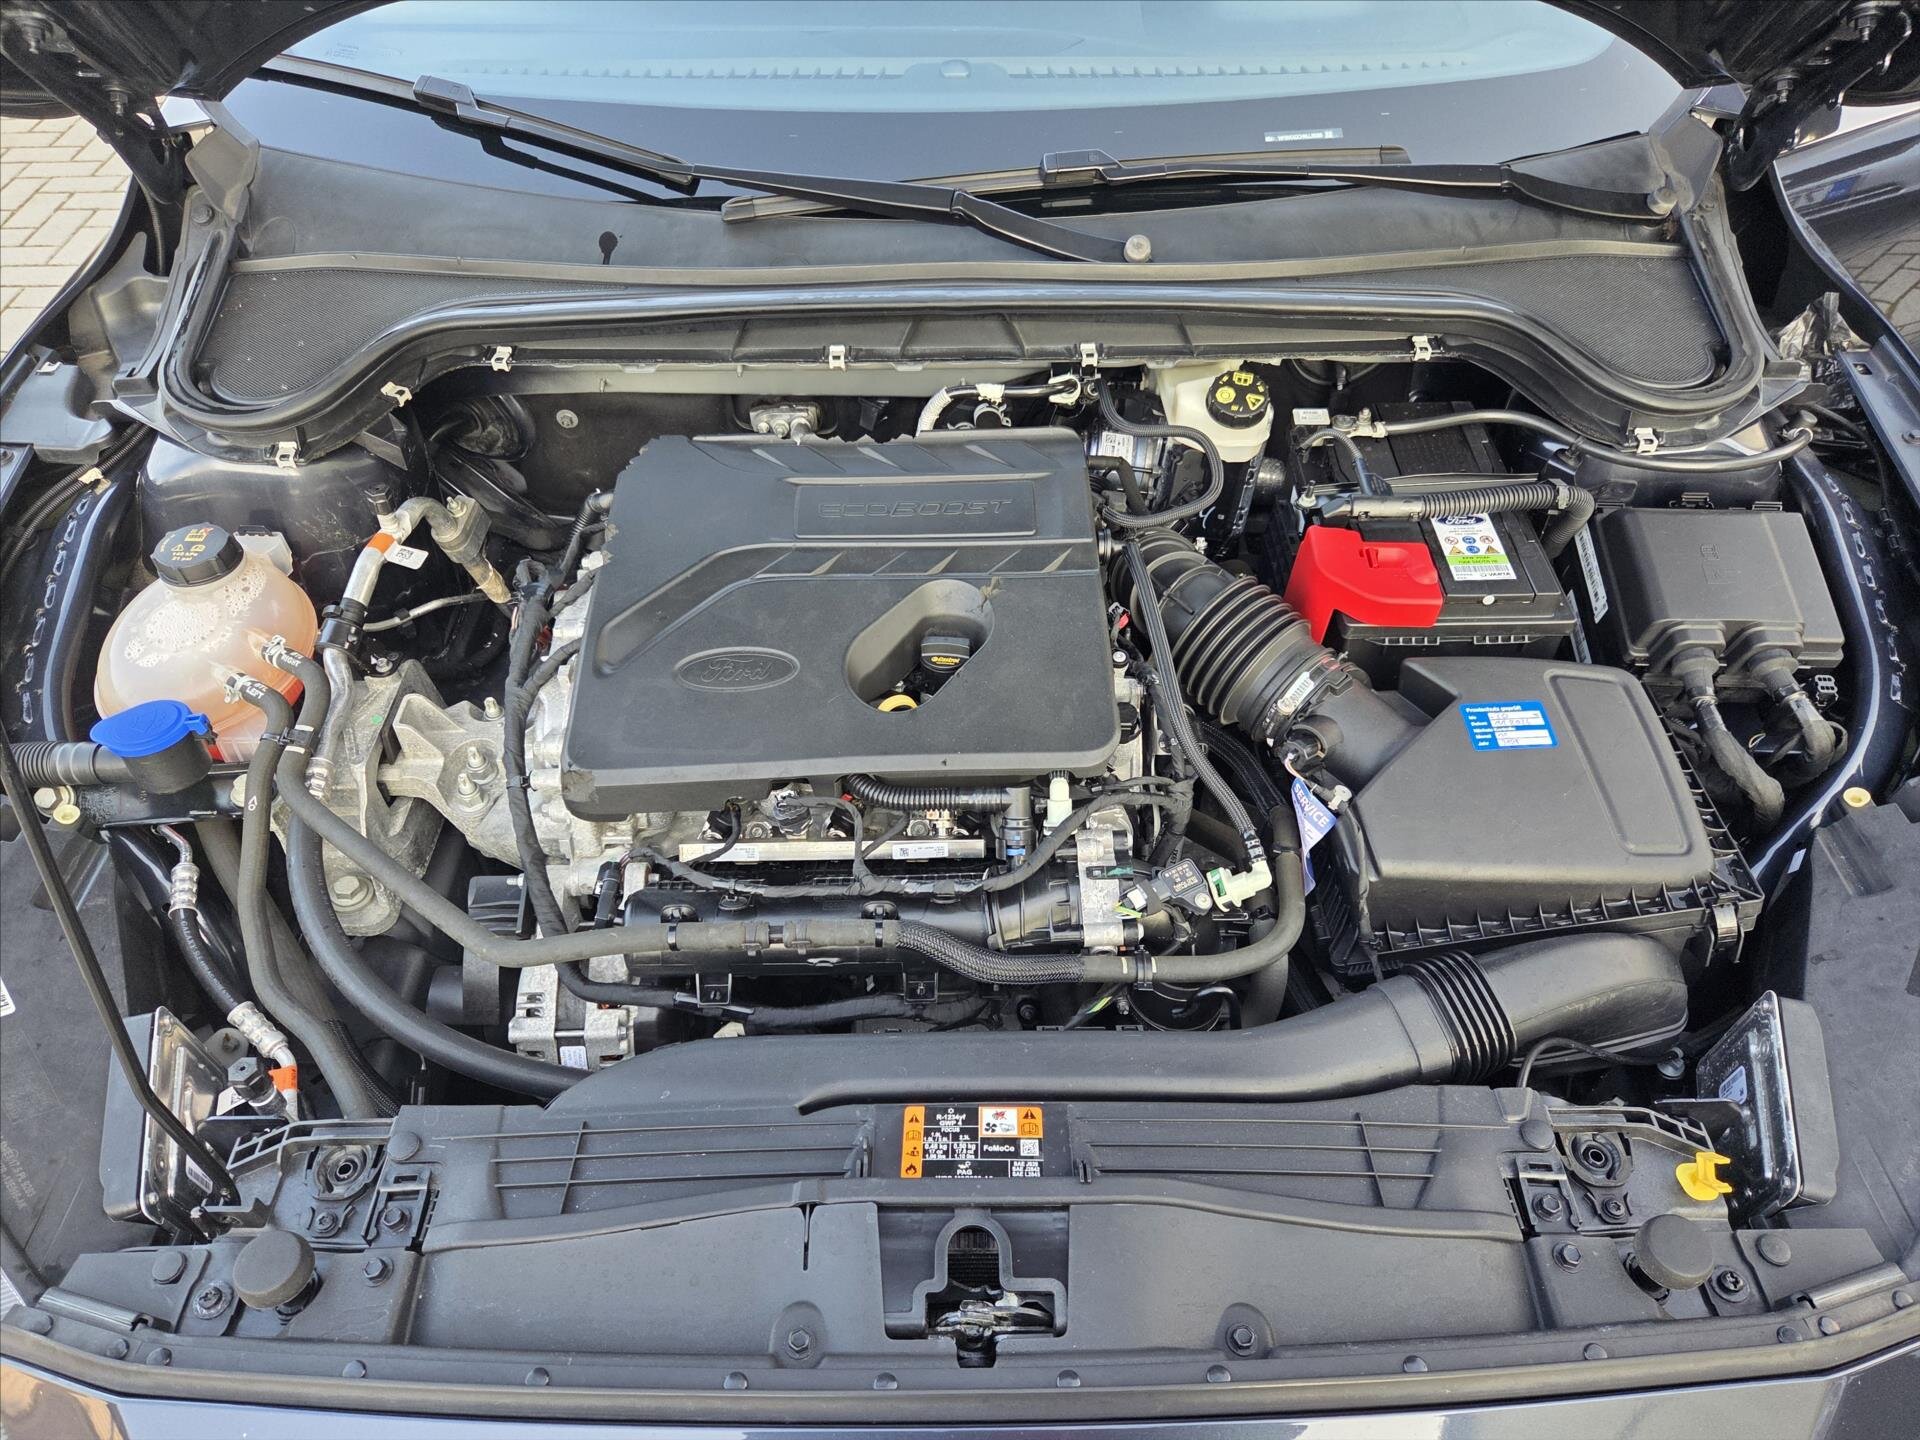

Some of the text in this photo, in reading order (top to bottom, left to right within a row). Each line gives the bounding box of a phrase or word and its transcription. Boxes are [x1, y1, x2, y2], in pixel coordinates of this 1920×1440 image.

[1445, 514, 1477, 525] Ford
[281, 653, 302, 667] RIGHT
[701, 657, 774, 682] Ford
[246, 685, 265, 699] LEFT
[1294, 783, 1330, 828] SERVICE
[936, 1113, 966, 1122] R-1234yf
[983, 1144, 1015, 1152] FoMoCo
